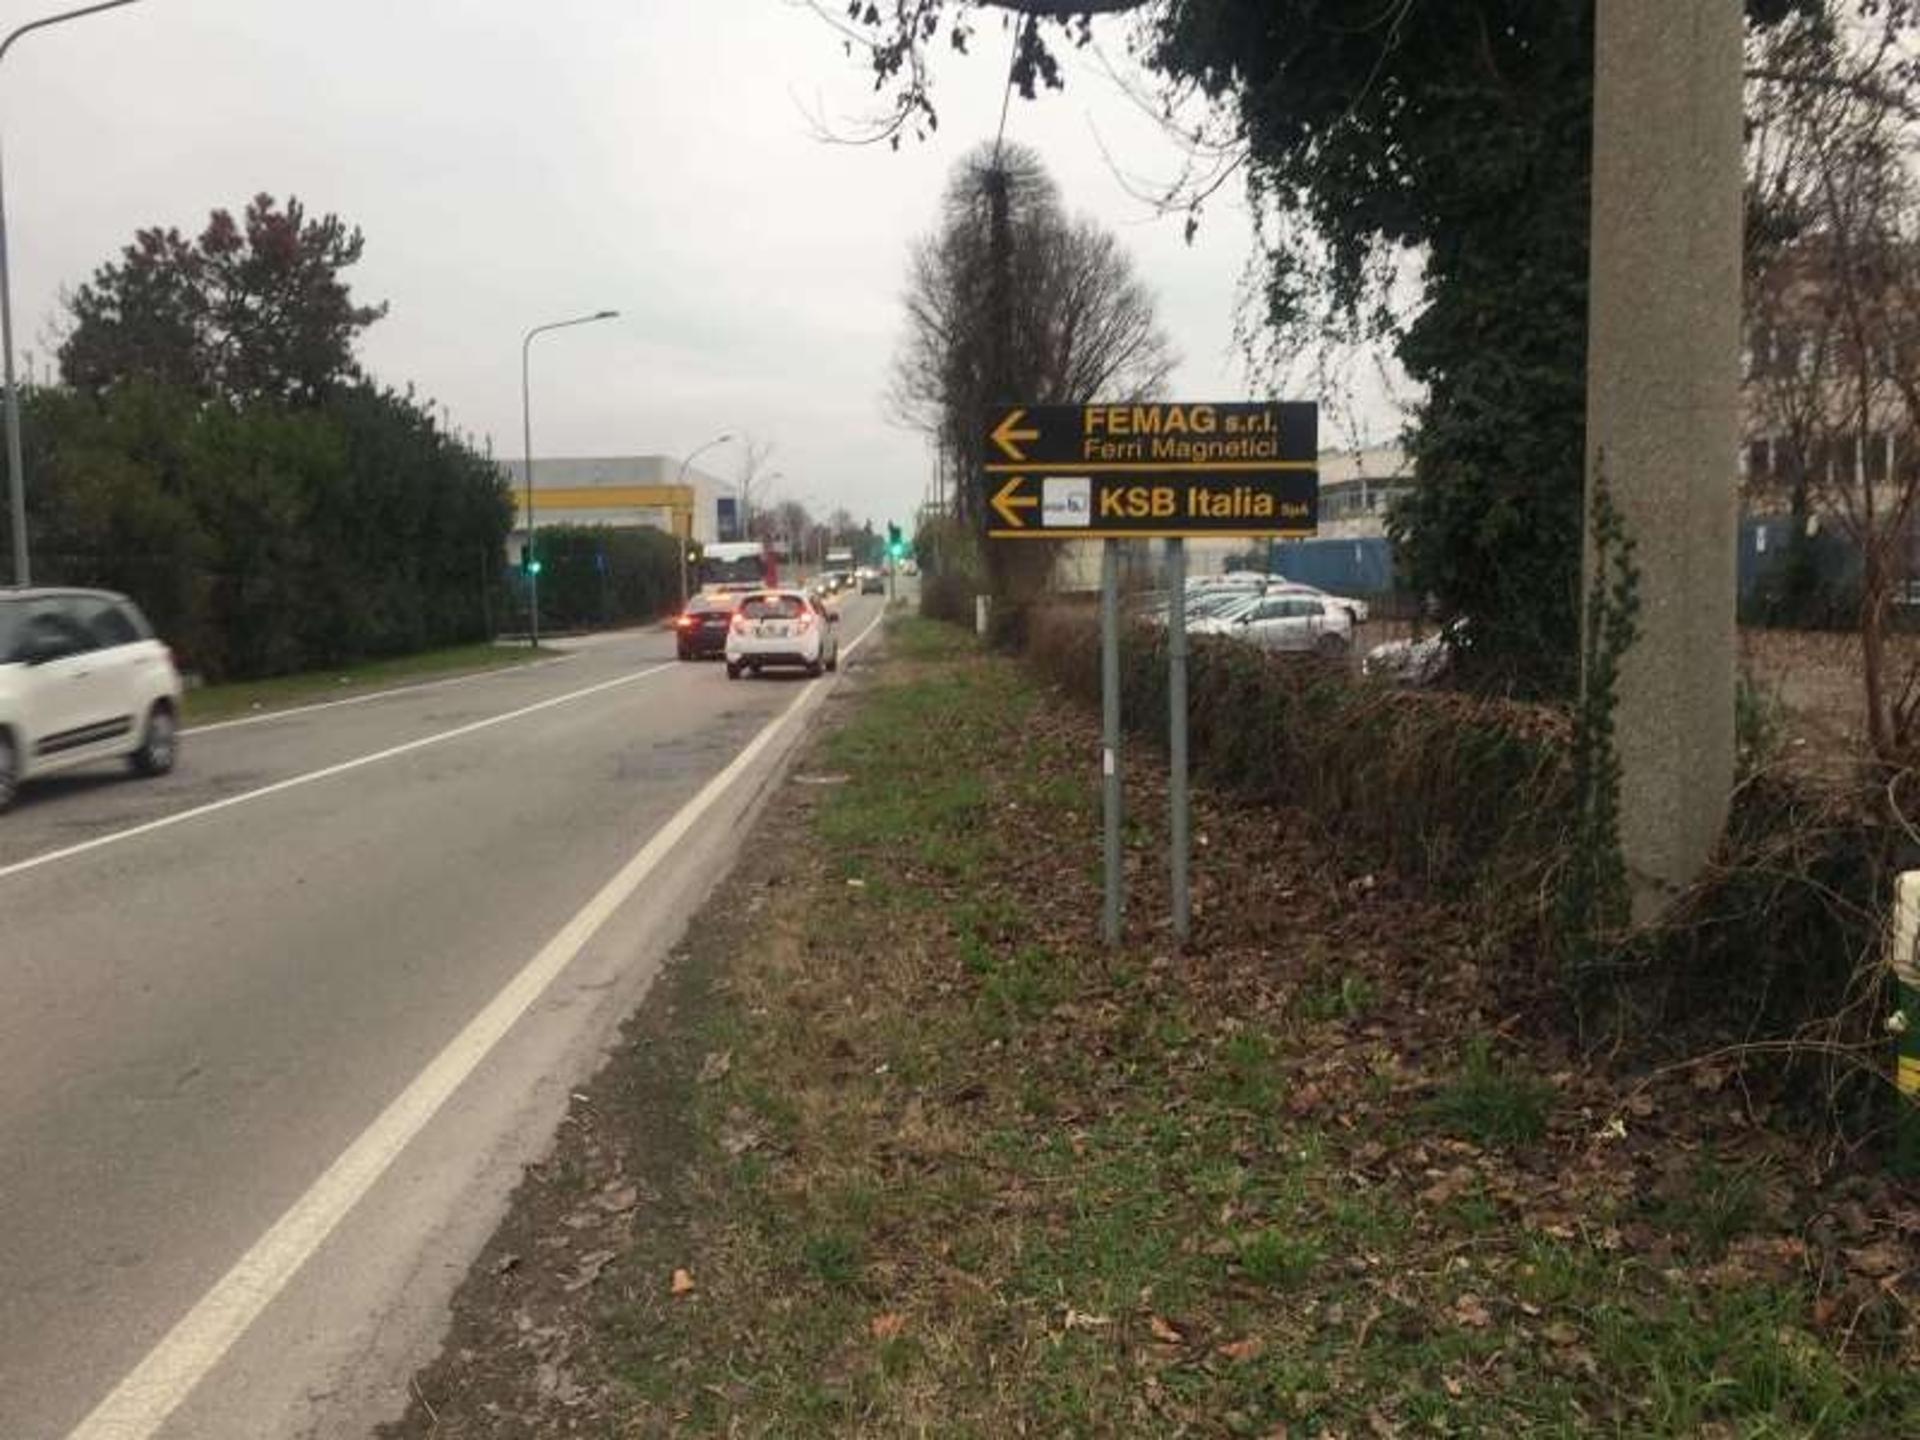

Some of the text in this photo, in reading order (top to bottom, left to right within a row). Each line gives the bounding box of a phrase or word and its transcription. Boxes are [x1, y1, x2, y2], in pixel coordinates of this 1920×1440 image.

[1084, 405, 1277, 434] FEMAG s.r.l.
[1084, 437, 1276, 463] Ferri Magnetici
[1101, 487, 1175, 517] KSB
[1188, 485, 1273, 516] Italia
